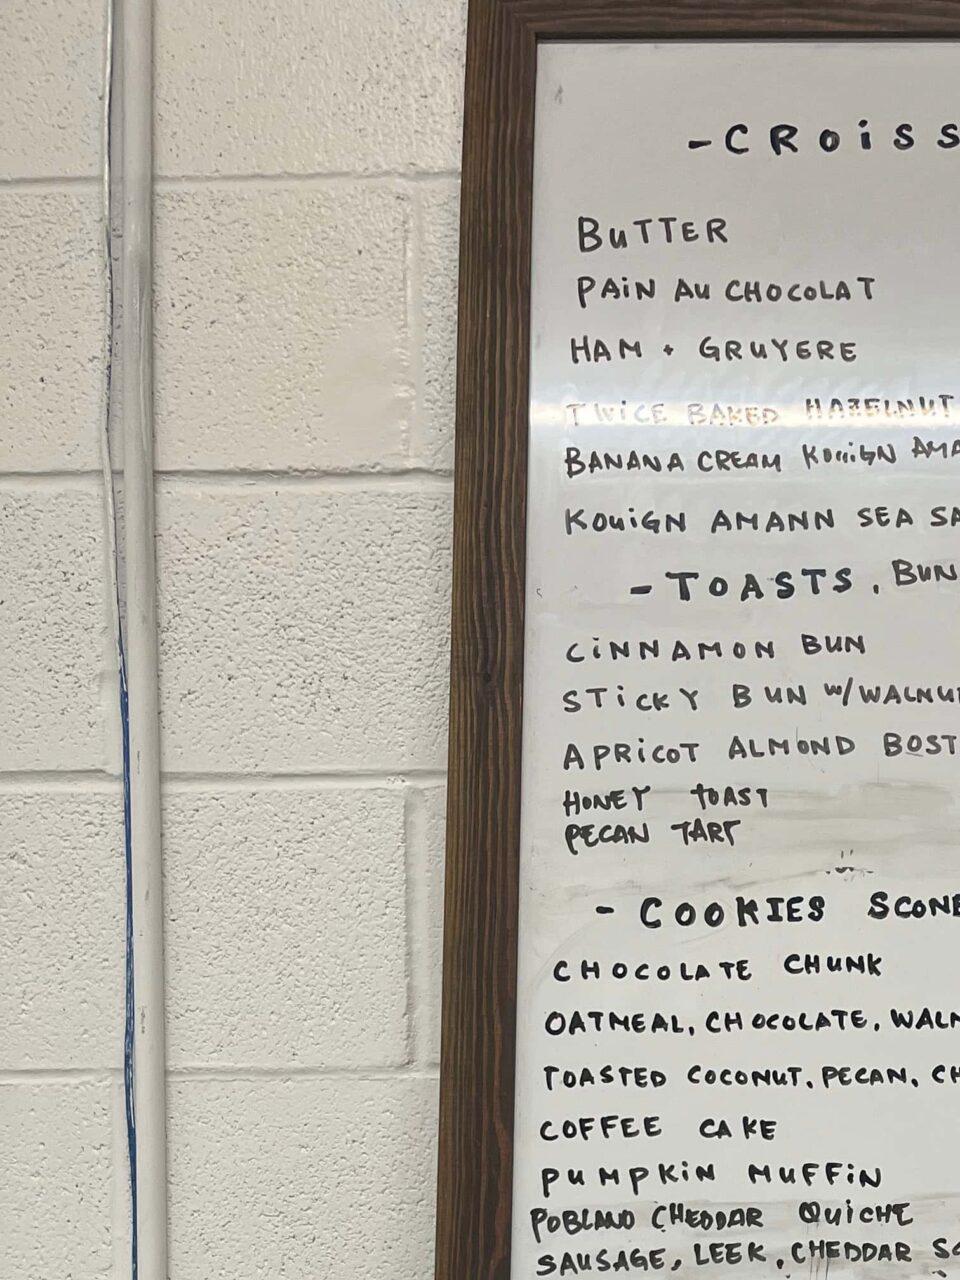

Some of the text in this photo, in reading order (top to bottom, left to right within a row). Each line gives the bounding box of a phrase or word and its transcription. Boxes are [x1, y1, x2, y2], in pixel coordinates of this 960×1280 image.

[577, 215, 728, 253] BUTTER
[674, 278, 711, 303] AU
[724, 276, 876, 303] CHOCOLAT
[570, 334, 643, 365] HAM
[698, 335, 857, 363] GRUYERE
[688, 405, 779, 426] BAKED
[805, 394, 953, 419] HAZELNUT
[564, 446, 685, 479] BANANA
[697, 449, 782, 473] CREAM
[710, 508, 835, 534] AMANN
[856, 506, 914, 529] SEA
[800, 633, 866, 656] BUN
[732, 683, 807, 709] BUN
[728, 735, 856, 761] ALMOND
[562, 785, 652, 818] HONEY
[564, 822, 650, 856] PECAN
[670, 817, 742, 847] TART
[639, 895, 826, 930] COOKIES
[552, 959, 753, 983] CHOCOLATE
[783, 952, 883, 977] CHUNK
[544, 1010, 695, 1037] OATMEAL,
[543, 1064, 667, 1092] TOASTED
[539, 1114, 663, 1142] COFFEE
[698, 1115, 778, 1141] CAKE
[651, 1202, 764, 1231] CHEDDAR
[535, 1247, 682, 1277] SAUSAGE,
[791, 1239, 912, 1264] CHEDDAR
